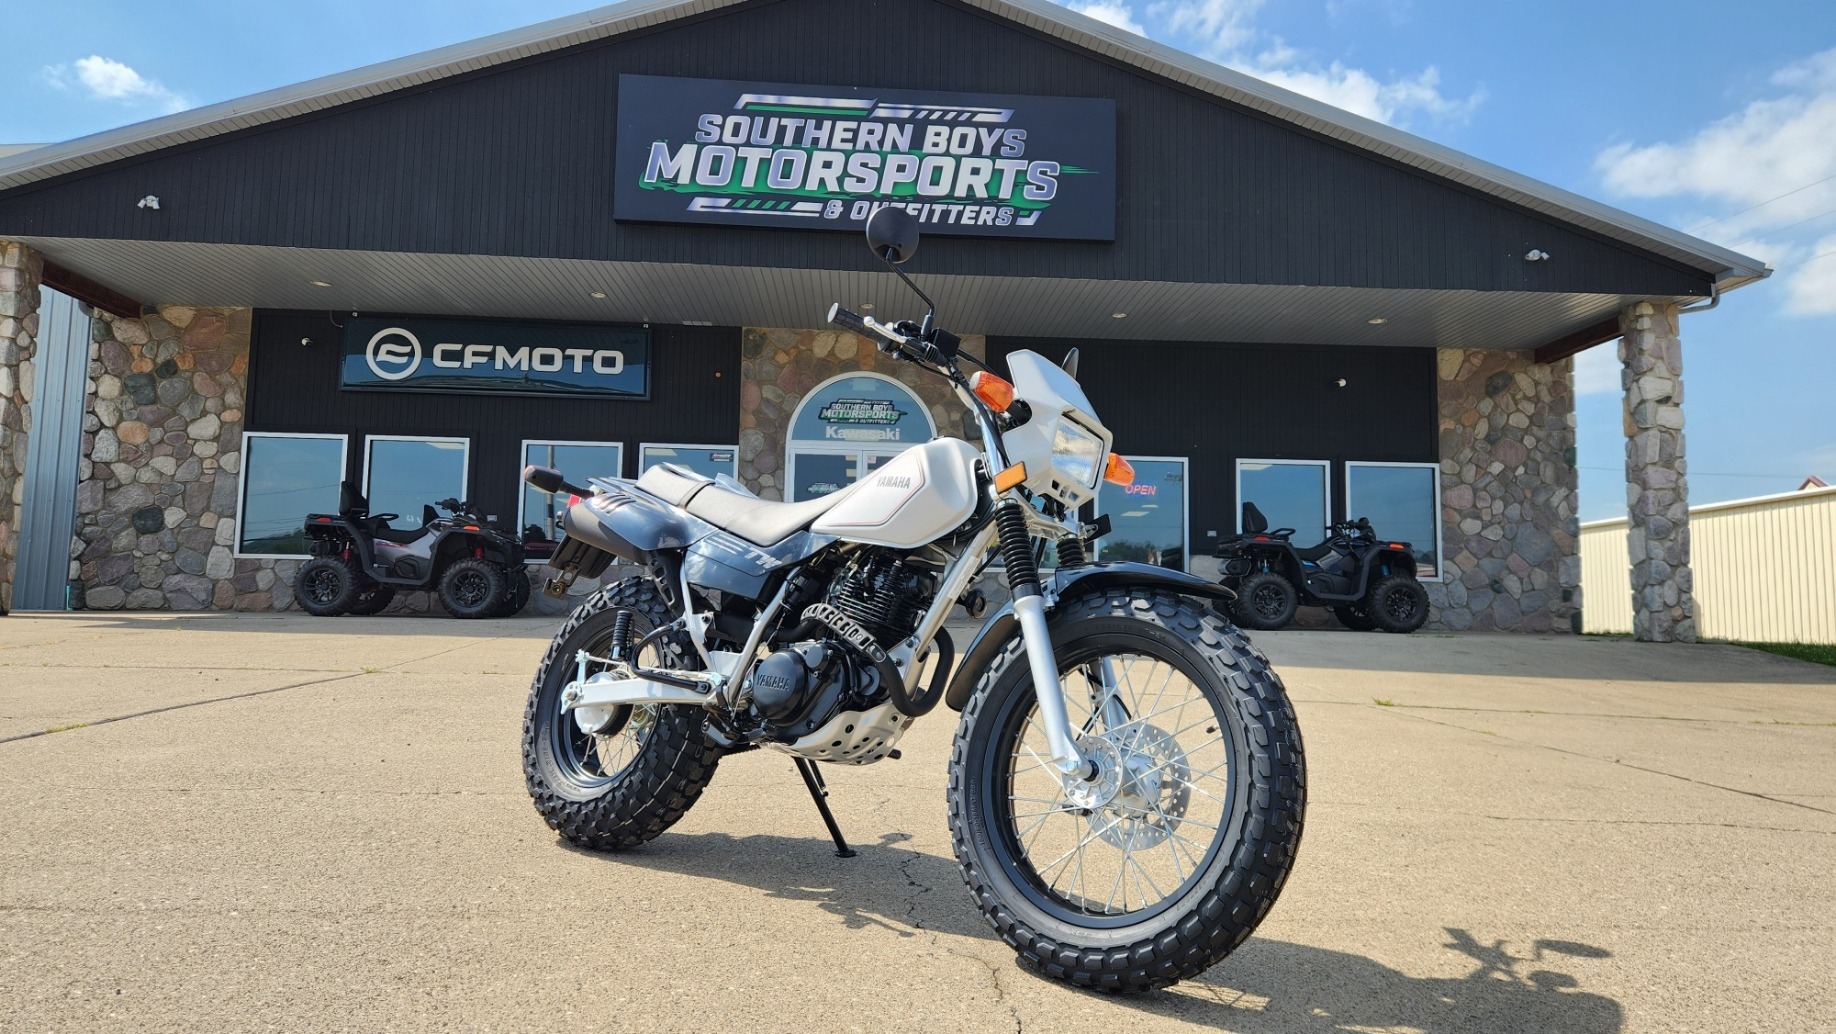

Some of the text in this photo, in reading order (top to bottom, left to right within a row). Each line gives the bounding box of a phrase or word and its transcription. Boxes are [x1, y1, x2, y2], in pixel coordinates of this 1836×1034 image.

[695, 114, 1027, 157] SOUTHERN BOYS
[645, 142, 1060, 200] MOTORSPORTS
[824, 200, 1014, 226] & OFITTERS
[432, 343, 624, 375] CFMOTO
[821, 409, 899, 420] MOTORSPORTS
[831, 403, 893, 412] SOUTHERN BOYS
[825, 425, 900, 440] Kawasaki
[877, 476, 911, 489] YAMAHA
[1125, 485, 1156, 495] OPEN
[757, 674, 790, 691] YAMAHA
